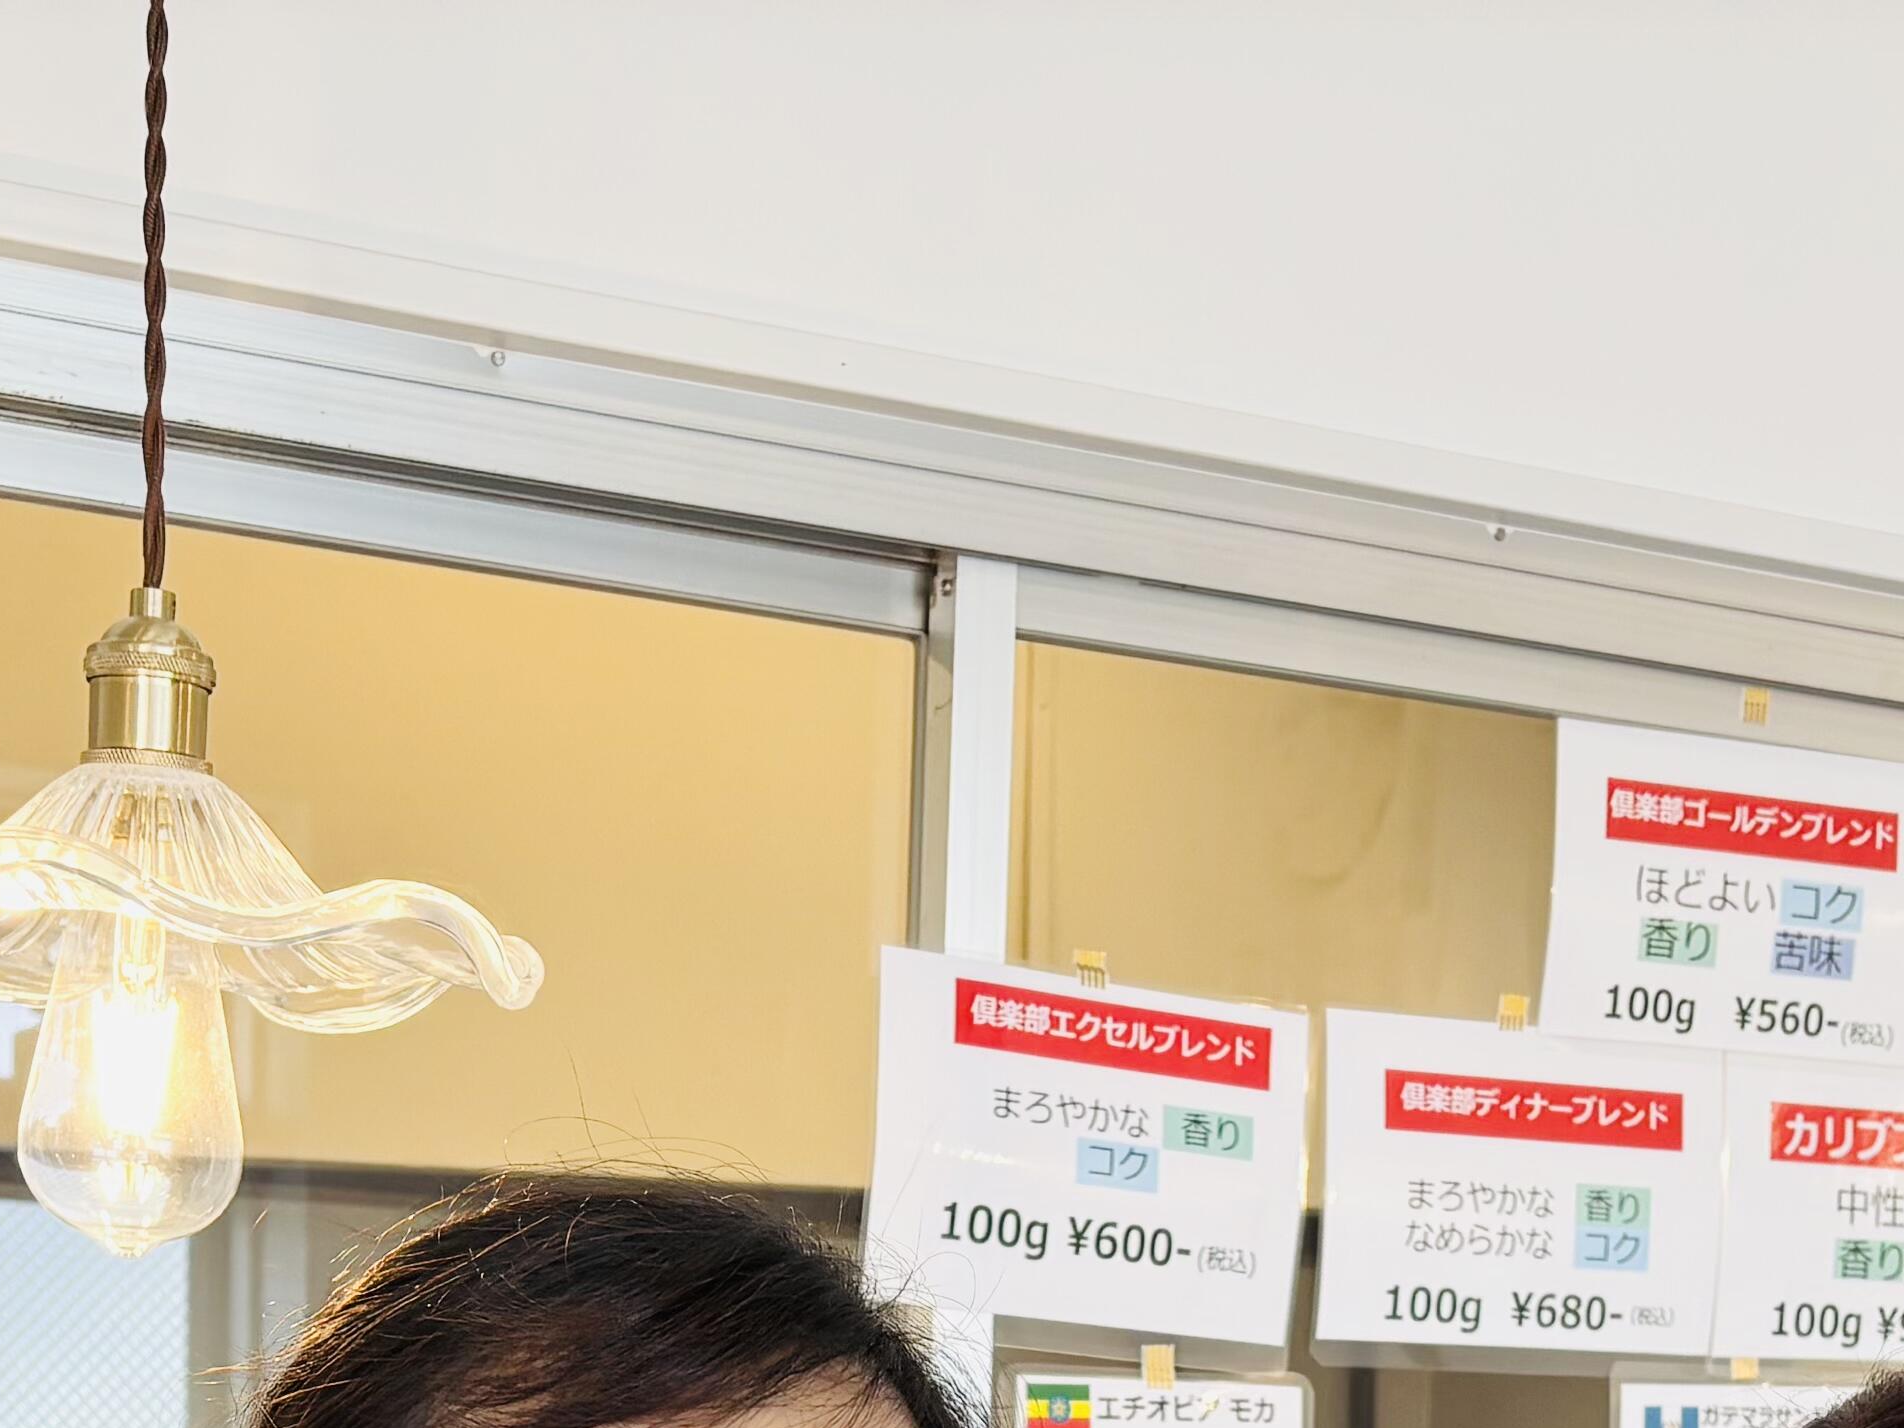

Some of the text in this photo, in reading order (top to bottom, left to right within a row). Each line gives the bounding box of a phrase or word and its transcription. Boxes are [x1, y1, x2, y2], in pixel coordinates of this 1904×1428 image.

[1609, 787, 1895, 851] 倶楽部ゴールデンブレンド
[1636, 864, 1858, 924] ほどよい コク
[1643, 917, 1843, 977] 香り 苦味
[970, 993, 1256, 1067] 倶楽部エクセルブレンド
[1604, 984, 1696, 1035] 100g
[992, 1086, 1240, 1152] まろやかな 香り
[1399, 1081, 1670, 1133] 倶楽部ディナーブレンド
[1087, 1144, 1149, 1182] コク
[1407, 1178, 1641, 1225] まろやかな 香り
[940, 1201, 1050, 1261] 100g
[1404, 1219, 1641, 1266] なめらかな コク
[1383, 1284, 1483, 1334] 100g
[1771, 1301, 1862, 1349] 100g
[1229, 1398, 1276, 1424] モカ
